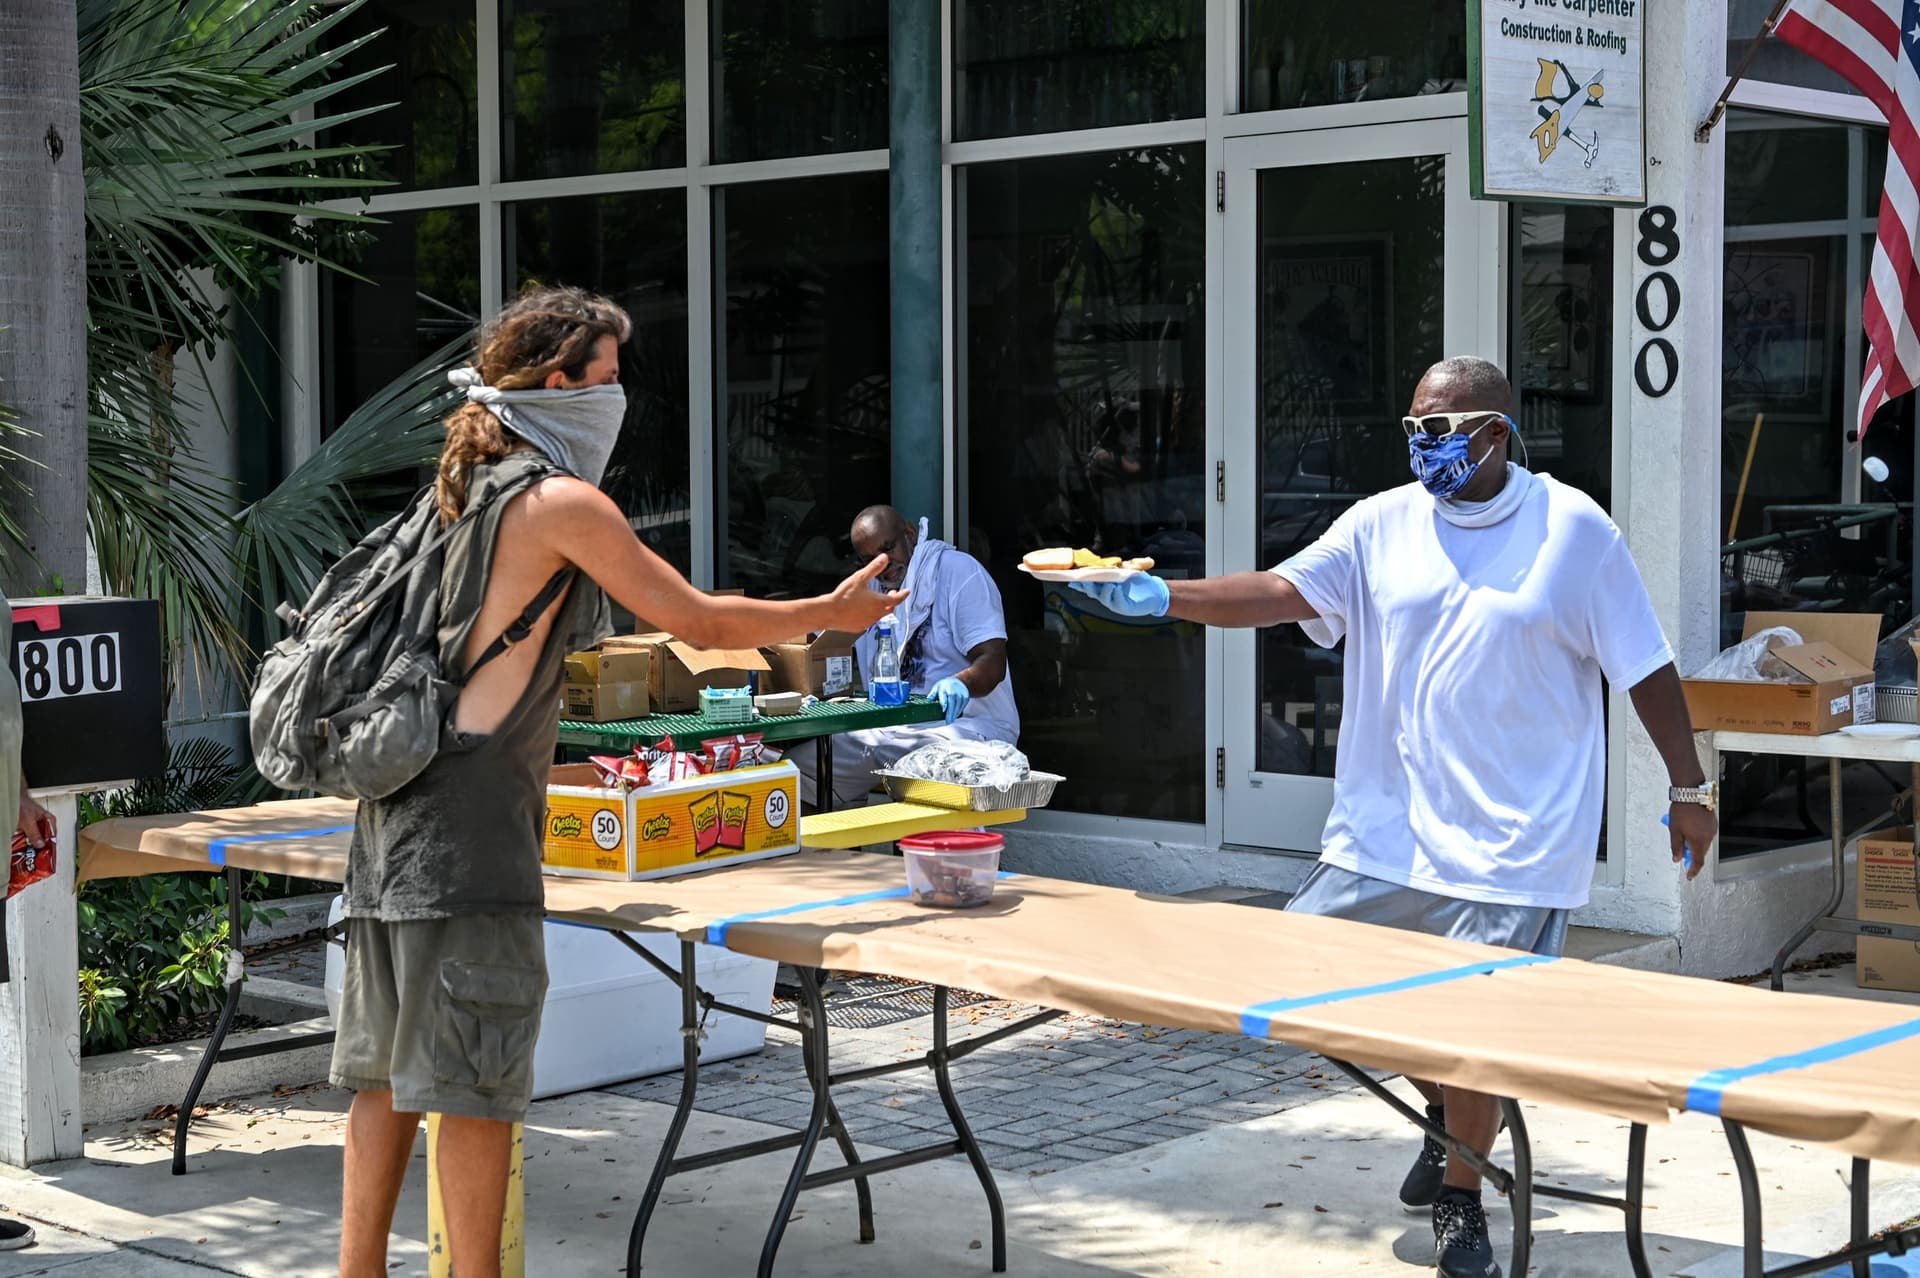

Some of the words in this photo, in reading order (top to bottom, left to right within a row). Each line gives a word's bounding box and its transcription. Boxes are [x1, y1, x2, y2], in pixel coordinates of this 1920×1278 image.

[1501, 17, 1572, 43] Construction
[1575, 26, 1583, 45] &
[1587, 28, 1627, 55] Roofing
[1634, 205, 1681, 398] 800
[24, 634, 117, 699] 800
[769, 796, 784, 814] 50
[551, 814, 582, 837] Cheetos
[597, 816, 615, 834] 50
[642, 814, 671, 841] Cheetos
[769, 813, 784, 822] Count
[597, 834, 616, 843] Count
